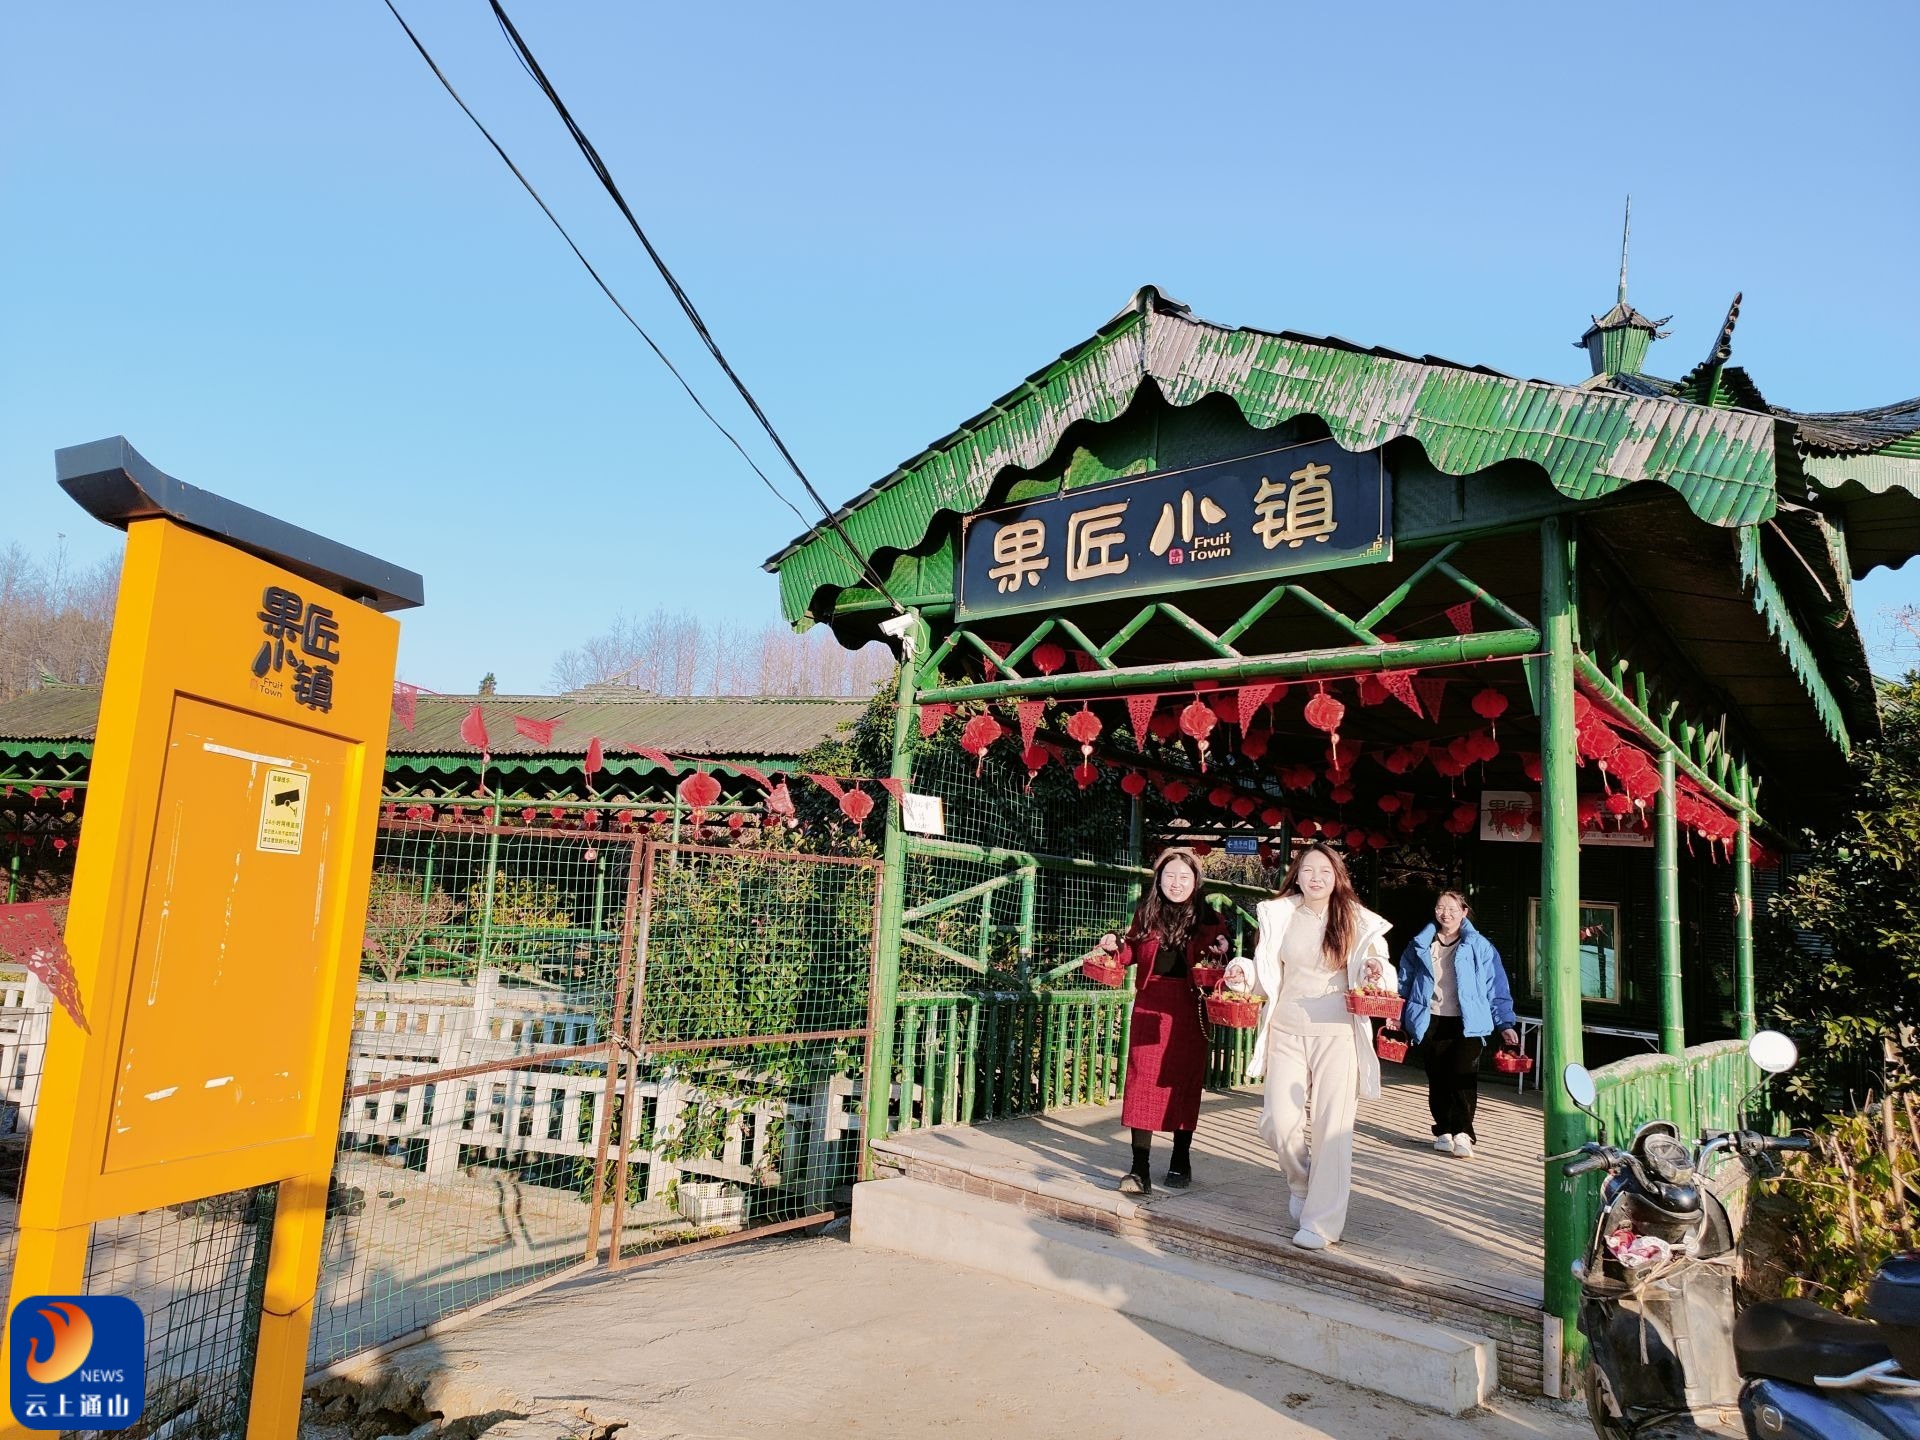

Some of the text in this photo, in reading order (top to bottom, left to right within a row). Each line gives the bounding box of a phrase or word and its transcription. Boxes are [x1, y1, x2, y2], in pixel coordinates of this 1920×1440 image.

[989, 463, 1338, 594] 果匠小镇
[1194, 532, 1231, 549] Fruit
[1188, 547, 1231, 562] Town
[257, 586, 340, 665] 果匠
[252, 638, 334, 714] 小镇
[263, 677, 284, 690] Fruit
[259, 685, 283, 698] Town
